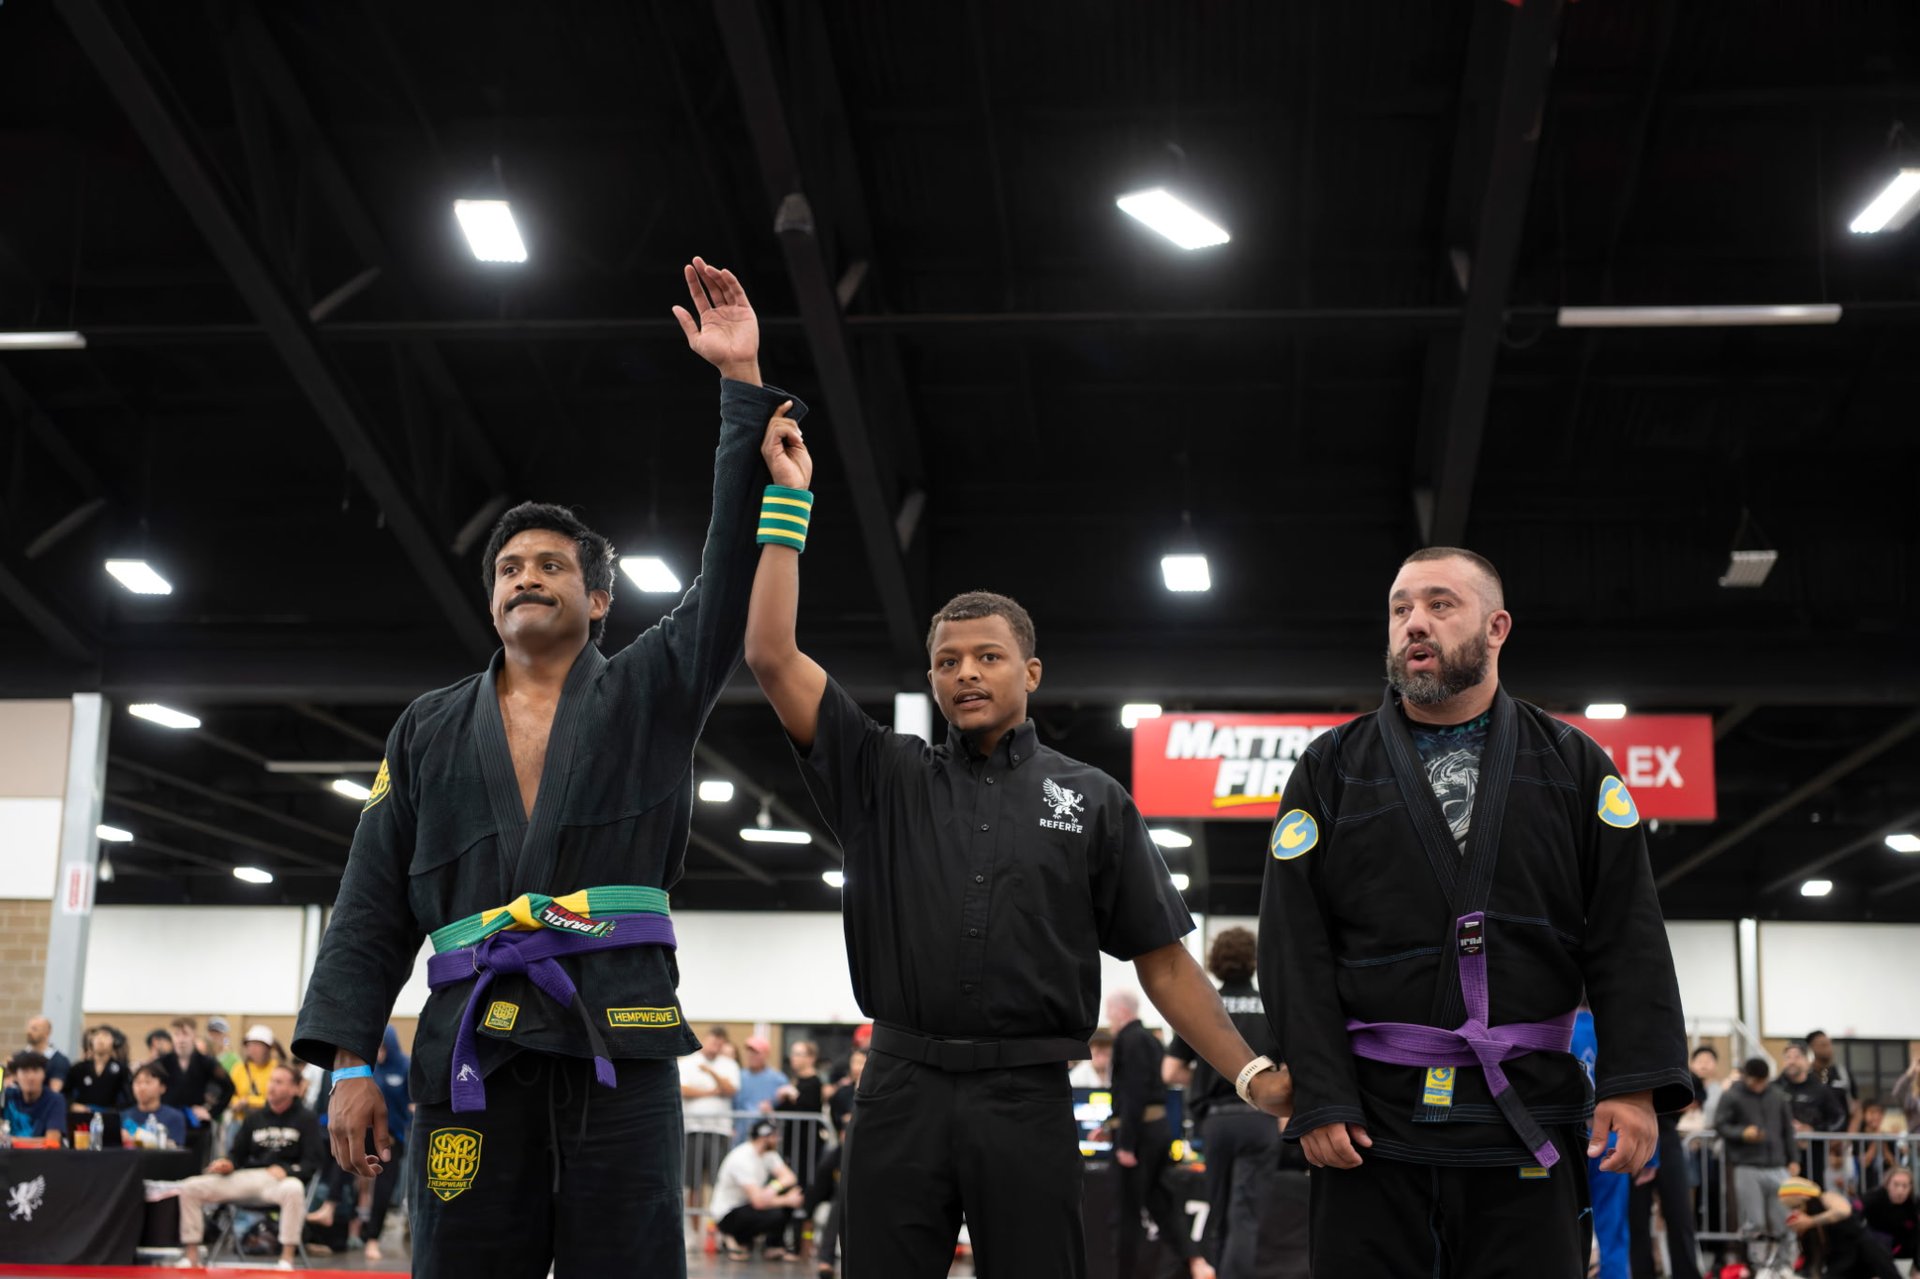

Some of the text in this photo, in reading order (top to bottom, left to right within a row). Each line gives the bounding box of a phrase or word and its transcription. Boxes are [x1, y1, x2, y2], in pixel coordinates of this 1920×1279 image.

[1040, 818, 1083, 833] REFEREE
[543, 909, 594, 932] BRAZIL
[614, 1011, 674, 1022] HEMPWEAVE
[431, 1180, 467, 1188] HEMPWEAVE
[1184, 1200, 1210, 1242] 7
